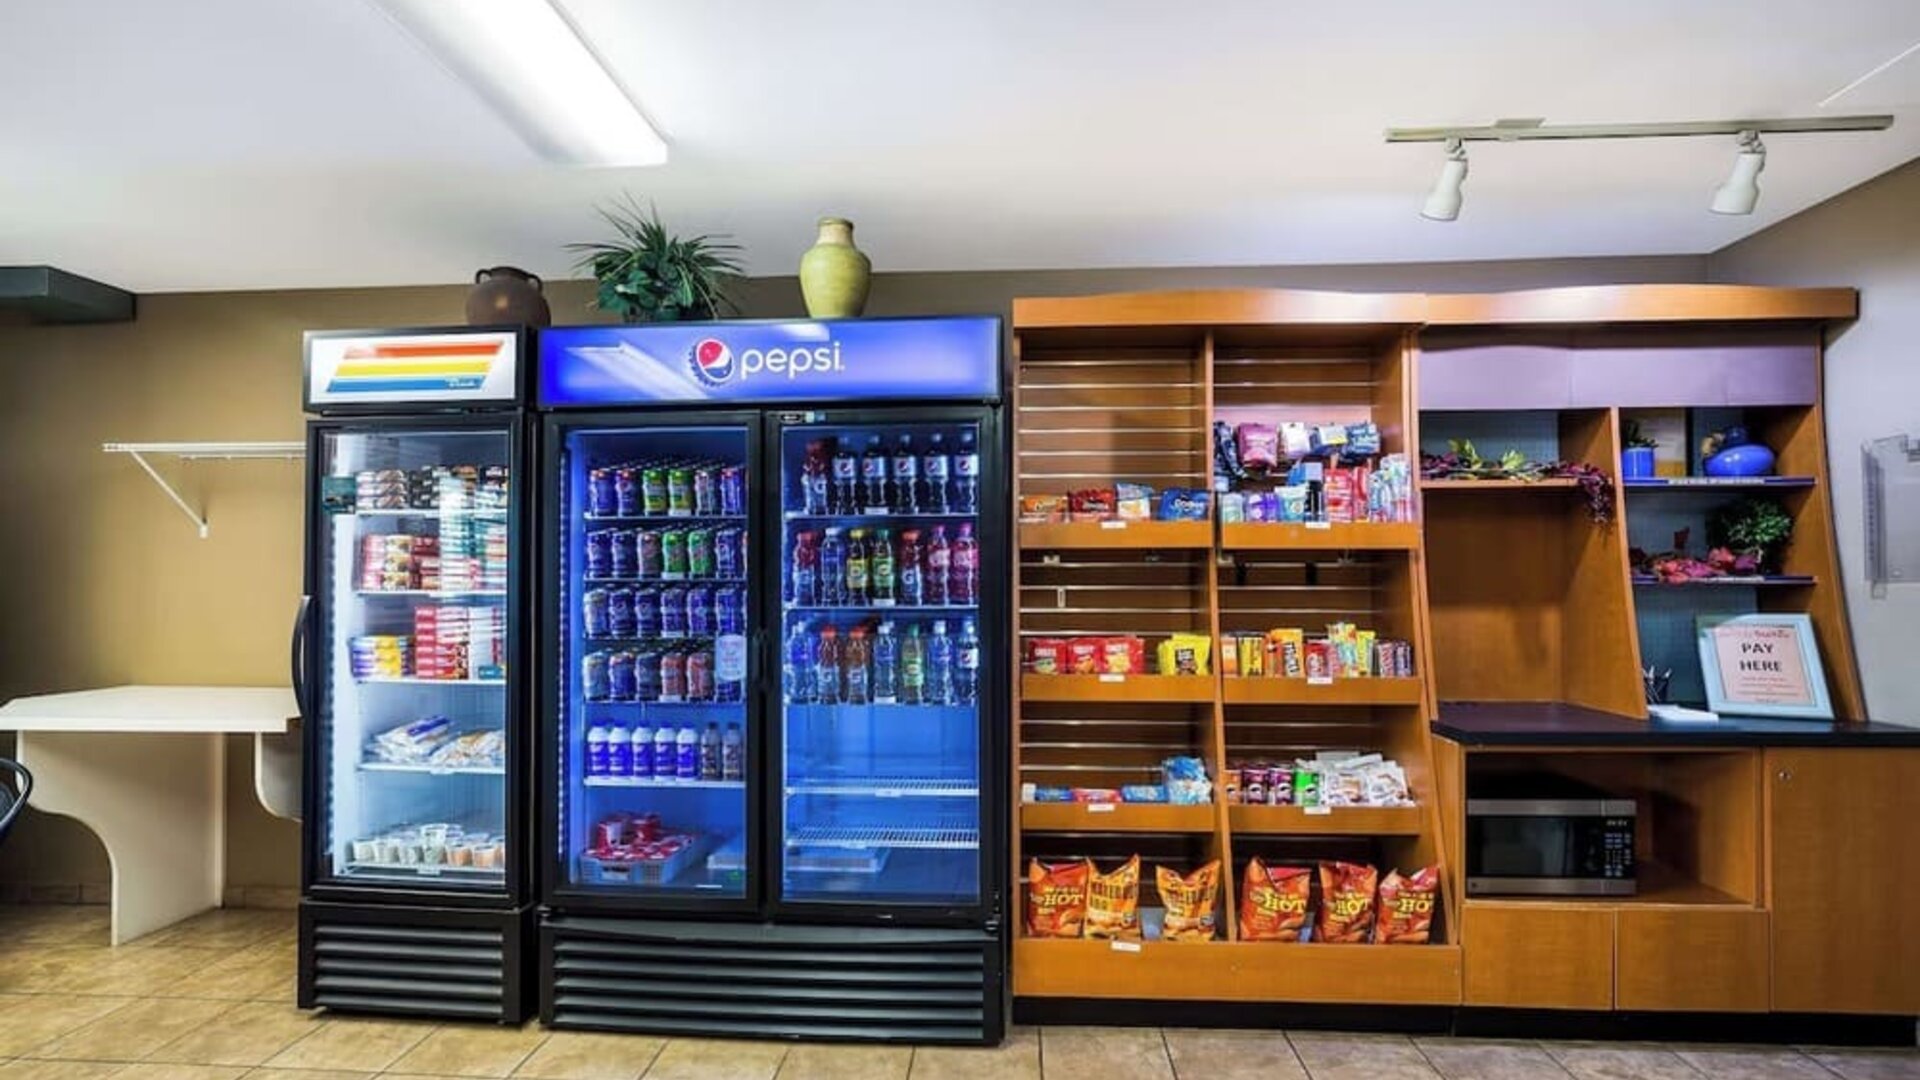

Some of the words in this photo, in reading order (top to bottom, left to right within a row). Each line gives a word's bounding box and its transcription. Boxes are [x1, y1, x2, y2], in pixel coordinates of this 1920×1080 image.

[740, 341, 844, 380] pepsi
[1741, 643, 1773, 654] PAY
[1739, 660, 1782, 672] HERE
[1044, 894, 1084, 906] HOT
[1264, 894, 1305, 913] HOT
